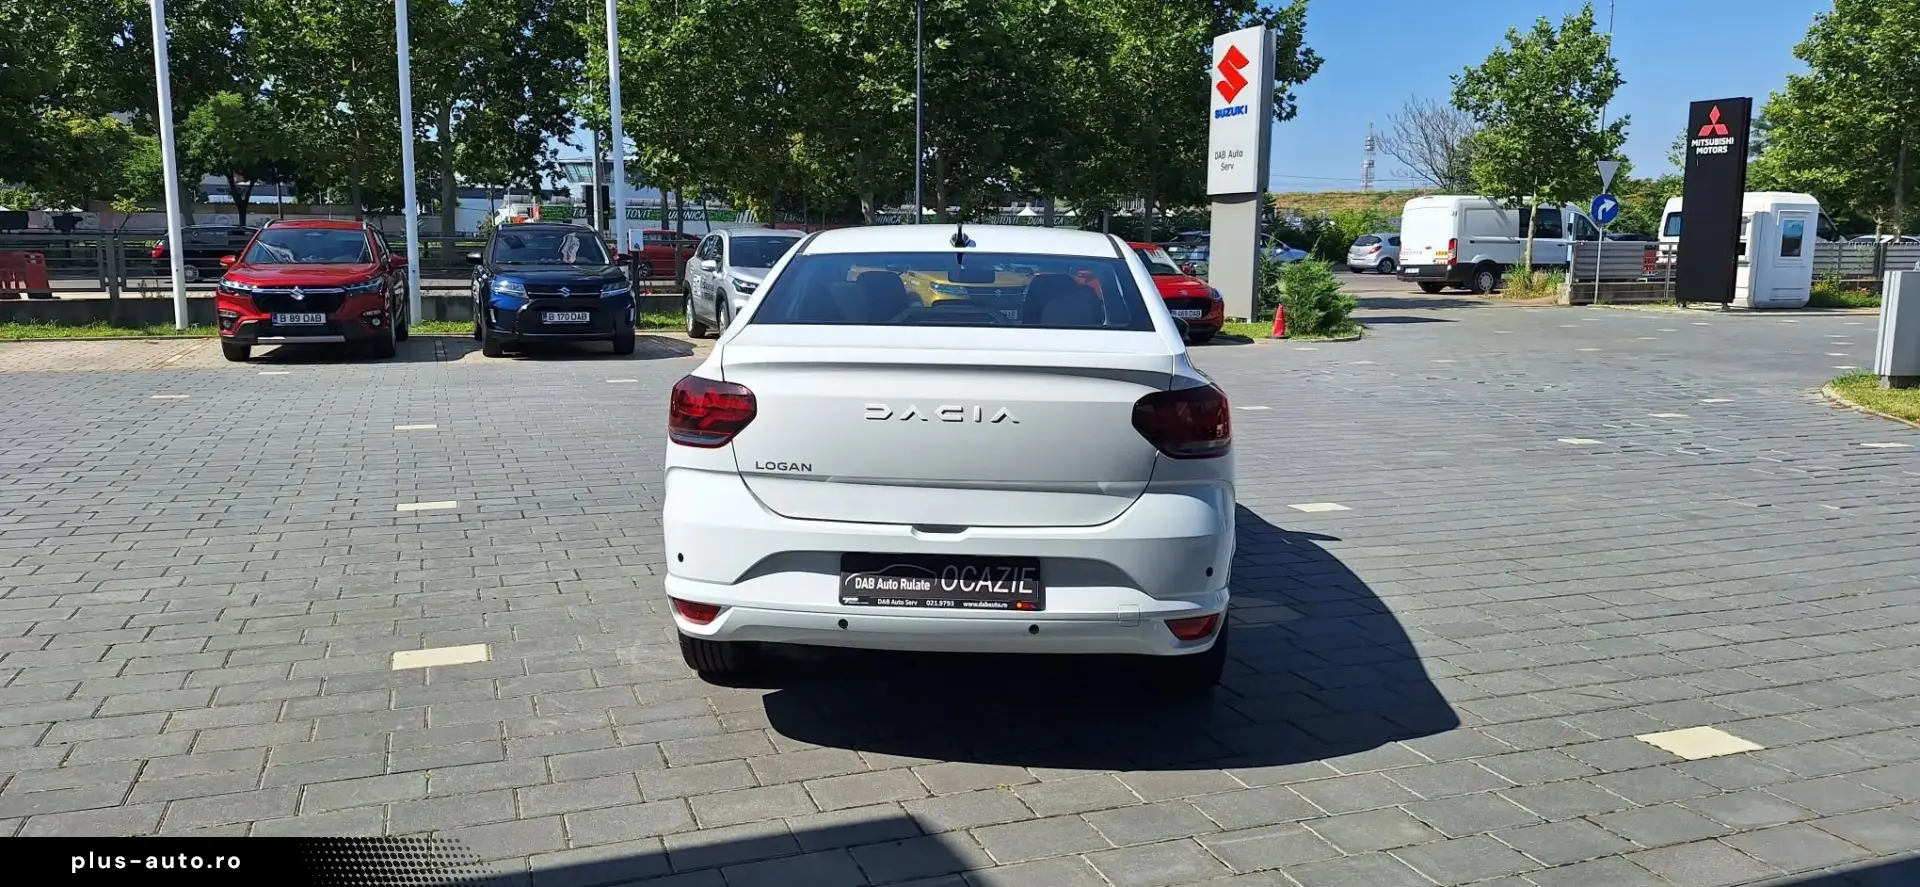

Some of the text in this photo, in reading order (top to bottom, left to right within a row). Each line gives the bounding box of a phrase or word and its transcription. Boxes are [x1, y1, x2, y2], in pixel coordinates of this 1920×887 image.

[1214, 105, 1248, 119] SUZUKI
[1691, 137, 1734, 147] MITSUBISHI
[1214, 150, 1243, 160] DAB Auto
[1696, 146, 1728, 155] MOTORS
[1220, 162, 1235, 171] Serv
[280, 314, 322, 323] B 89 DAB
[548, 312, 588, 321] B 170 DAB
[865, 403, 1020, 424] DACIA
[755, 460, 812, 472] LOGAN
[855, 577, 931, 591] DAB Auto Rulate
[941, 564, 1036, 594] OCAZIE
[877, 598, 890, 606] DAB
[926, 599, 955, 608] 021.9793
